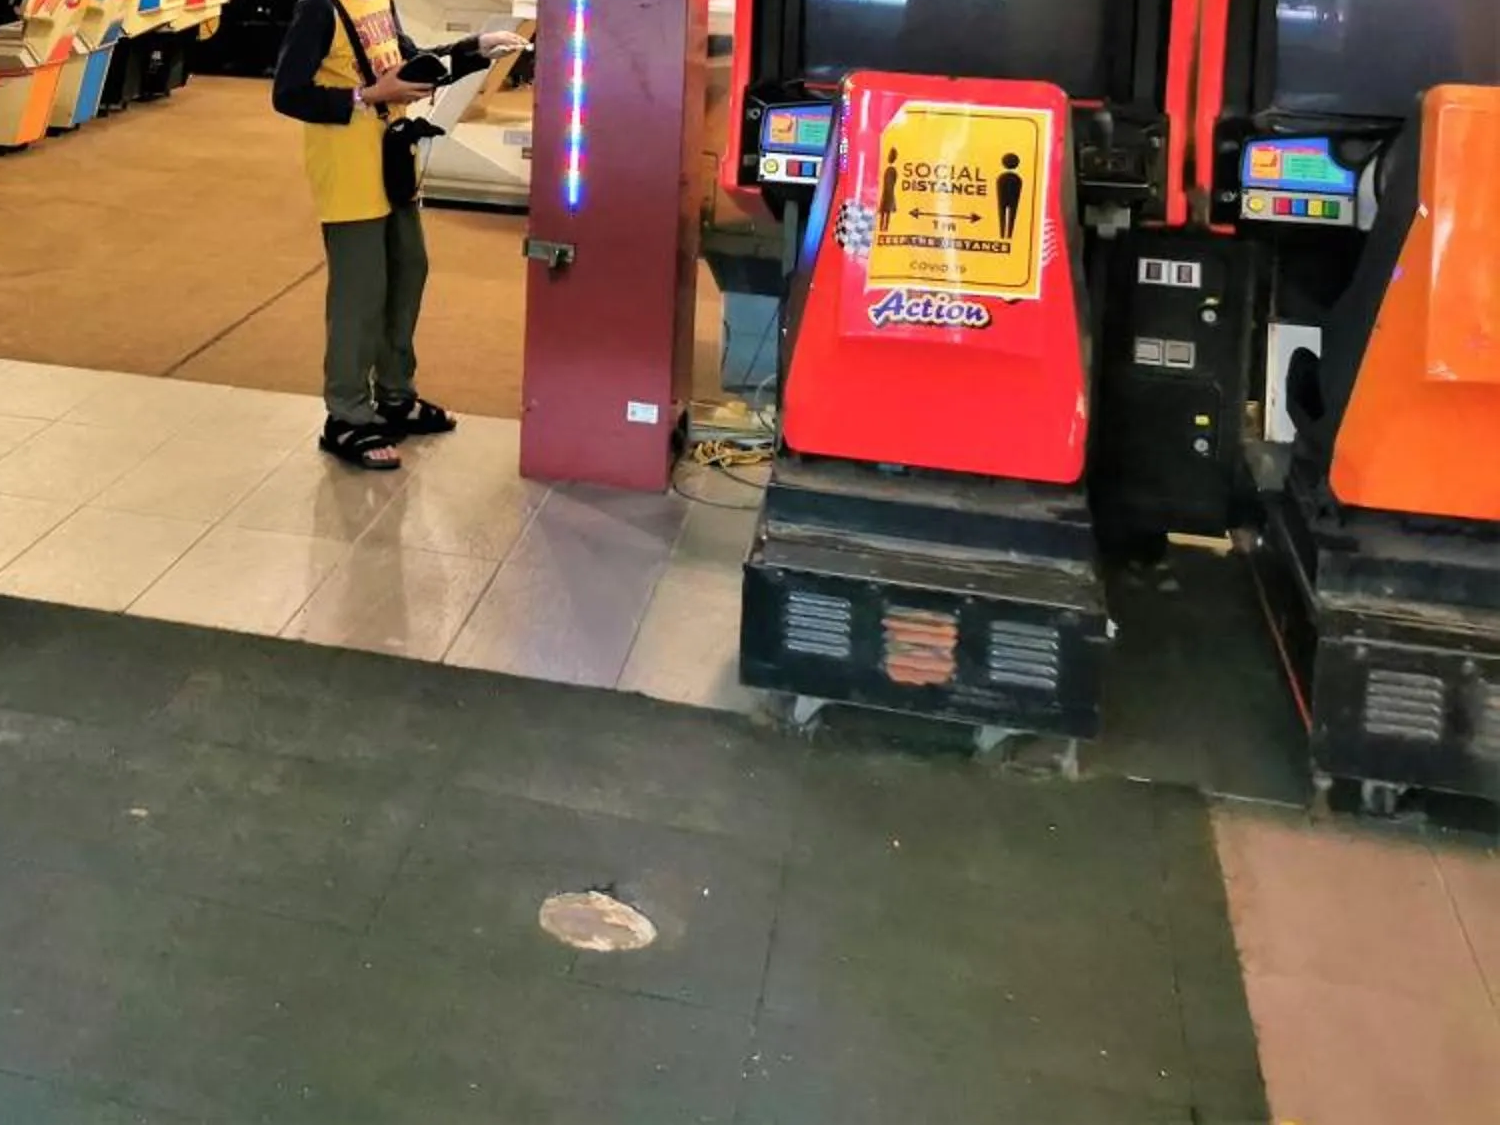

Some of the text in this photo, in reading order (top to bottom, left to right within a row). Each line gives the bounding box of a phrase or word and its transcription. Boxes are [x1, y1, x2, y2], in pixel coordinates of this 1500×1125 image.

[902, 162, 988, 183] SOCIAL
[901, 179, 988, 196] DISTANCE
[869, 289, 989, 325] Action
